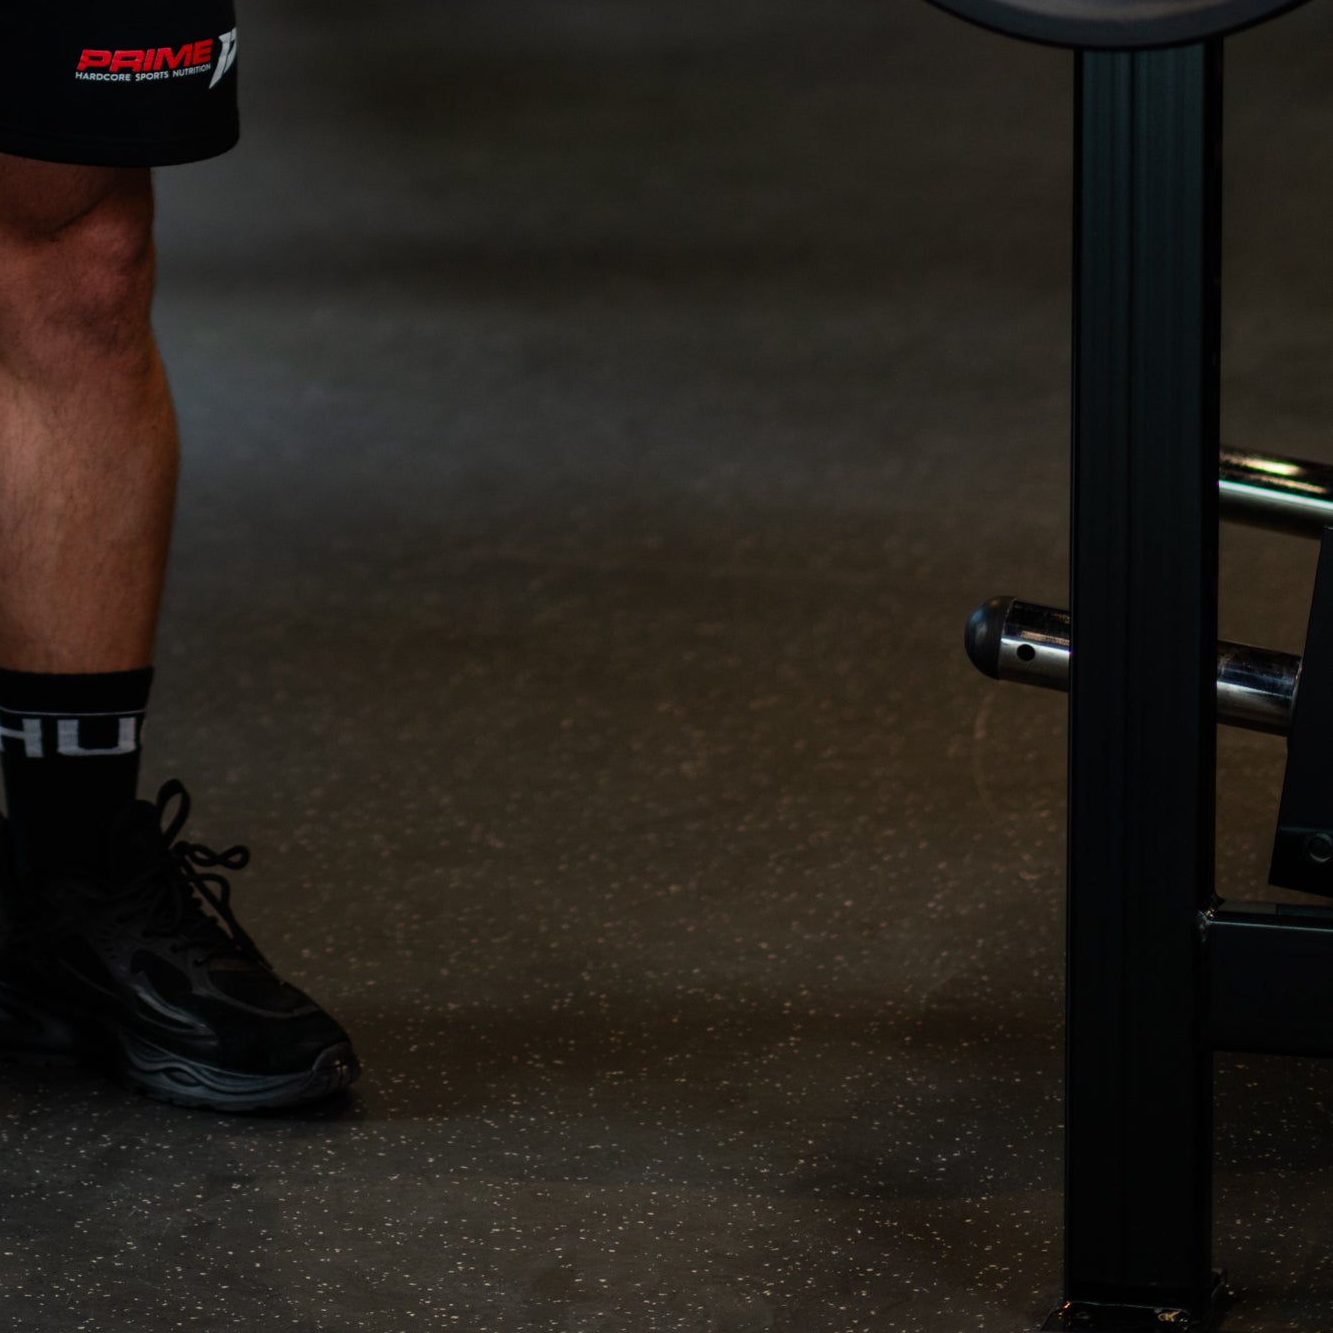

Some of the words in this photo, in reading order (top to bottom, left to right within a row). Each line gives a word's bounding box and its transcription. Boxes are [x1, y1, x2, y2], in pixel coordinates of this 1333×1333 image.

[77, 38, 213, 72] PRIME
[75, 71, 131, 82] HARDCORE
[135, 70, 169, 81] SPORTS
[172, 63, 211, 78] NUTRITION
